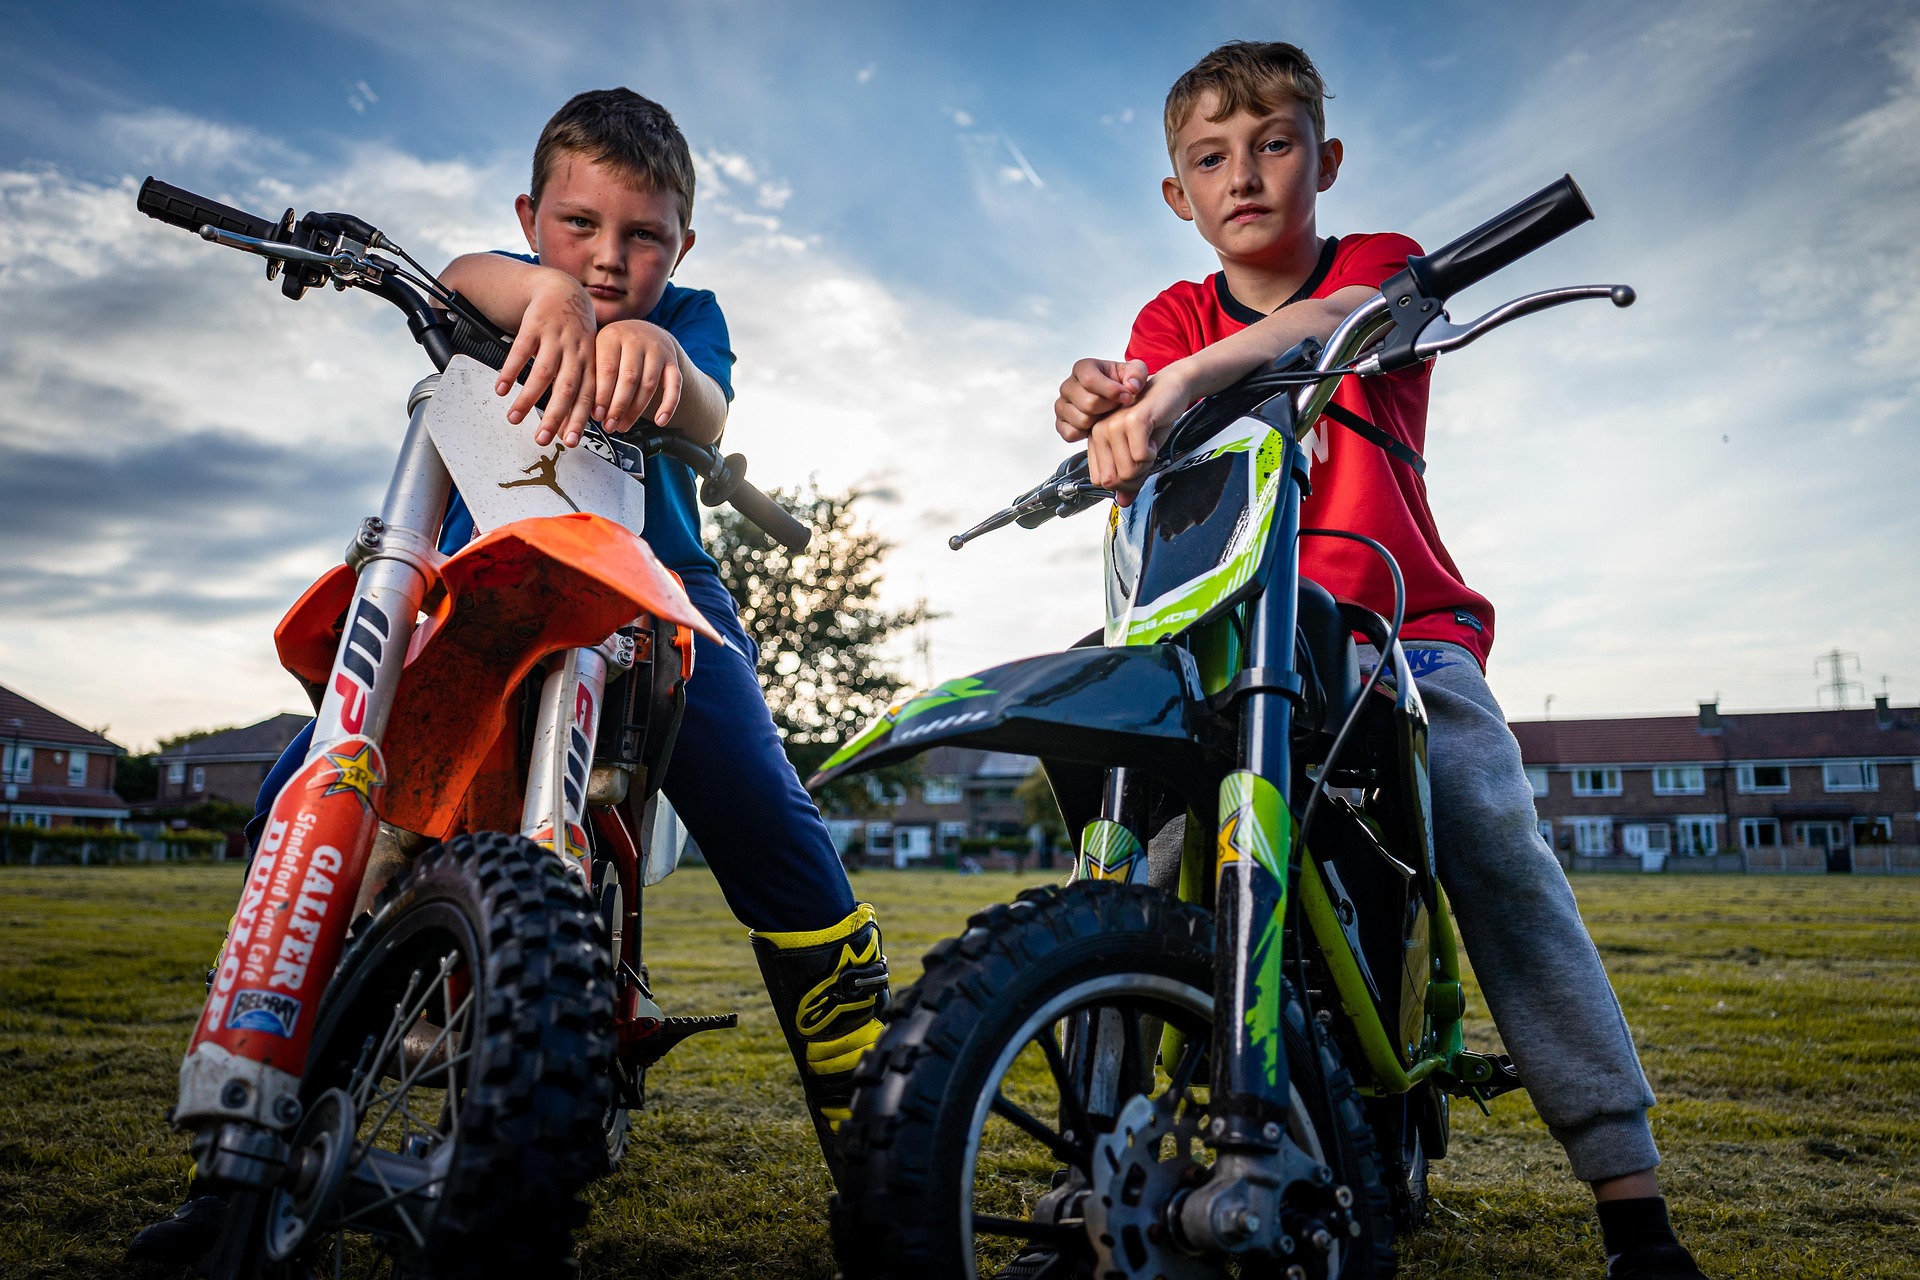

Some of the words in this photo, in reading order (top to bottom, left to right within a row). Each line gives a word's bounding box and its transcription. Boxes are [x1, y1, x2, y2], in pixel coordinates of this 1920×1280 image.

[1403, 649, 1444, 670] IKE
[271, 810, 318, 899] Standeford
[207, 817, 289, 1033] DUNLOP
[269, 845, 343, 990] GALFER
